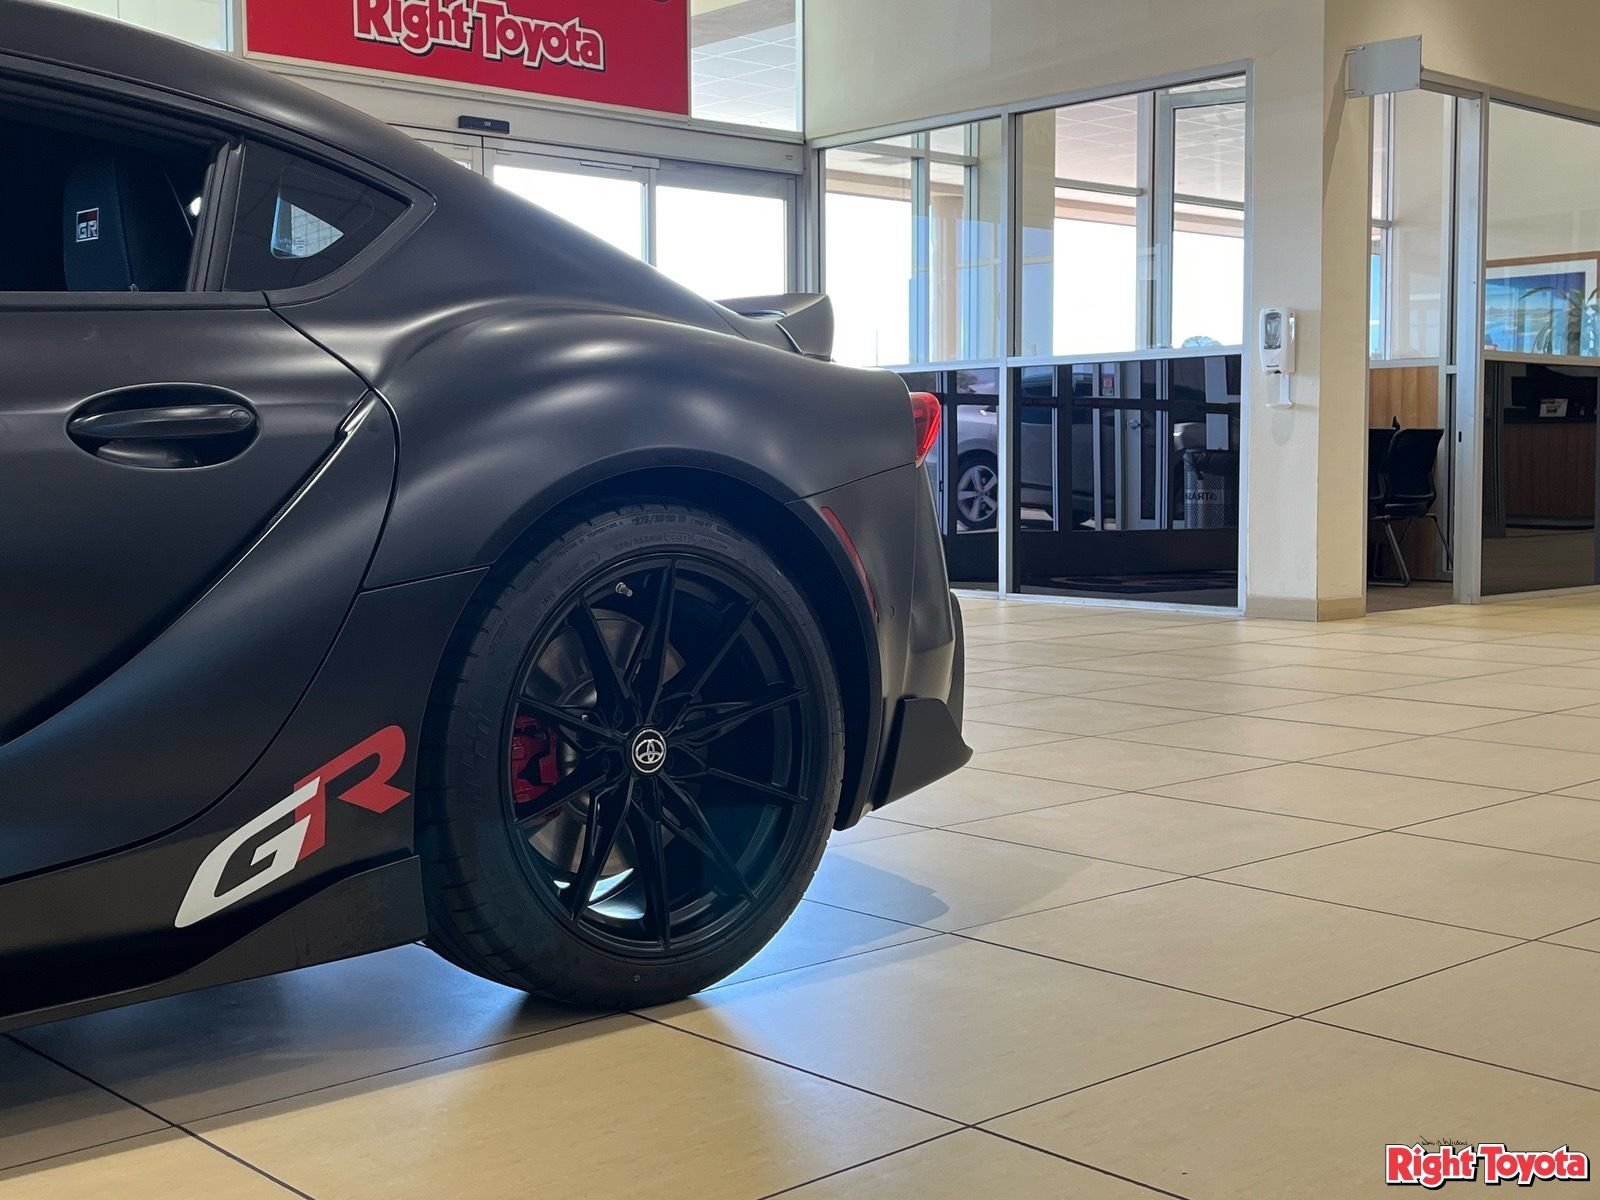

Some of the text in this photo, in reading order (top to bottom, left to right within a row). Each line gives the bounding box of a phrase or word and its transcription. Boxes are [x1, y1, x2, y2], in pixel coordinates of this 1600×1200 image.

[354, 0, 605, 70] Right Toyota
[78, 219, 98, 239] GR
[174, 725, 411, 928] GR
